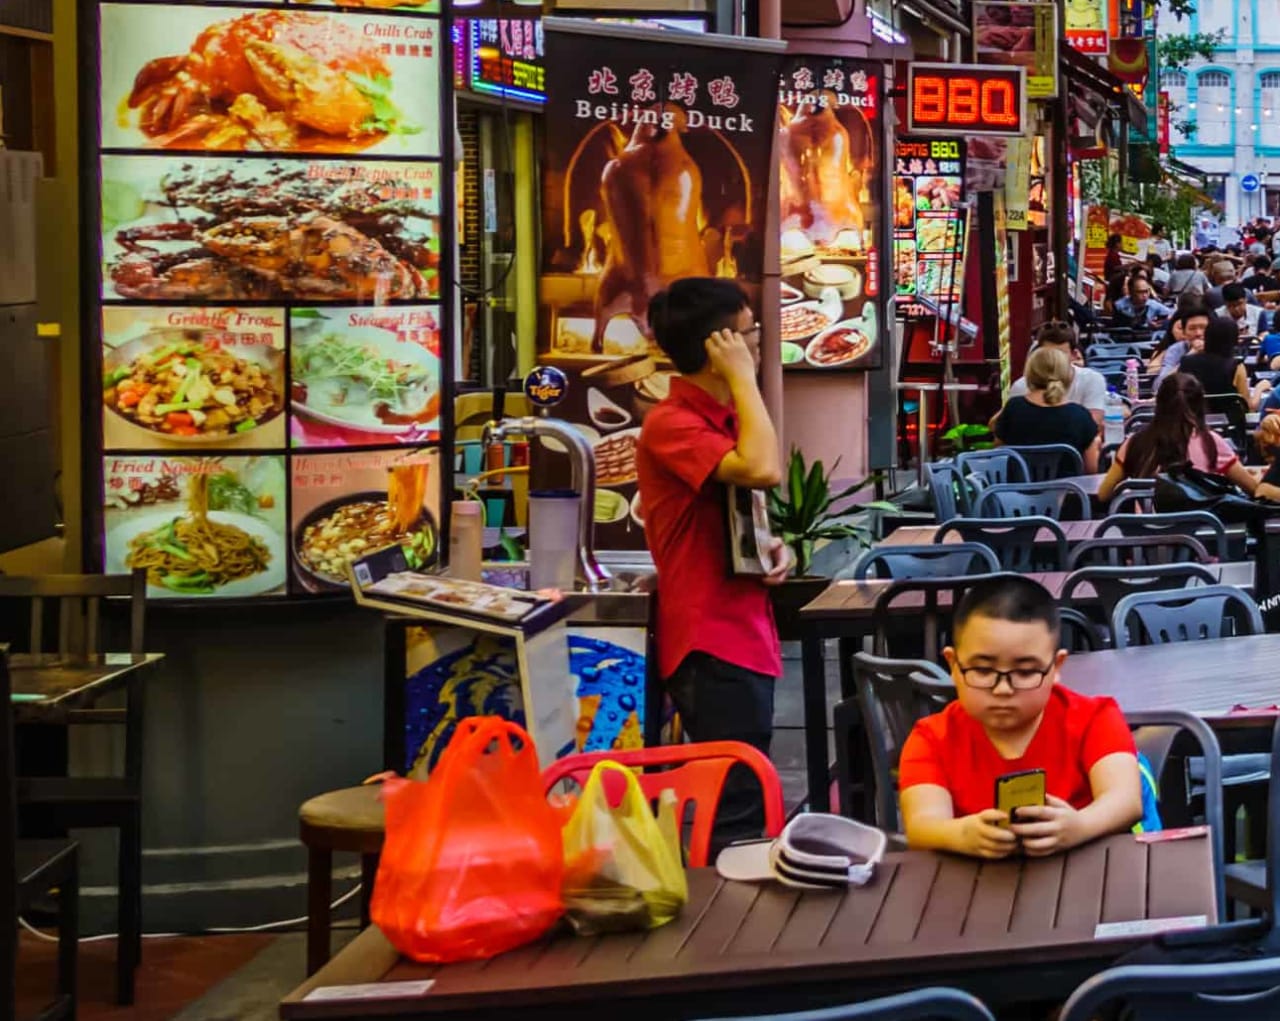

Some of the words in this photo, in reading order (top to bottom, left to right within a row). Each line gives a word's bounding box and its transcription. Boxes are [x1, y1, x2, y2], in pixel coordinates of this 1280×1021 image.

[363, 22, 400, 37] Chilli
[404, 25, 433, 39] Crab
[588, 66, 739, 108] 北京烤鸭
[779, 67, 869, 92] 京烤鸭
[838, 92, 875, 107] Duck
[914, 76, 1018, 126] BBQ
[575, 100, 675, 129] Beijing
[687, 110, 753, 133] Duck
[111, 460, 154, 474] Fried
